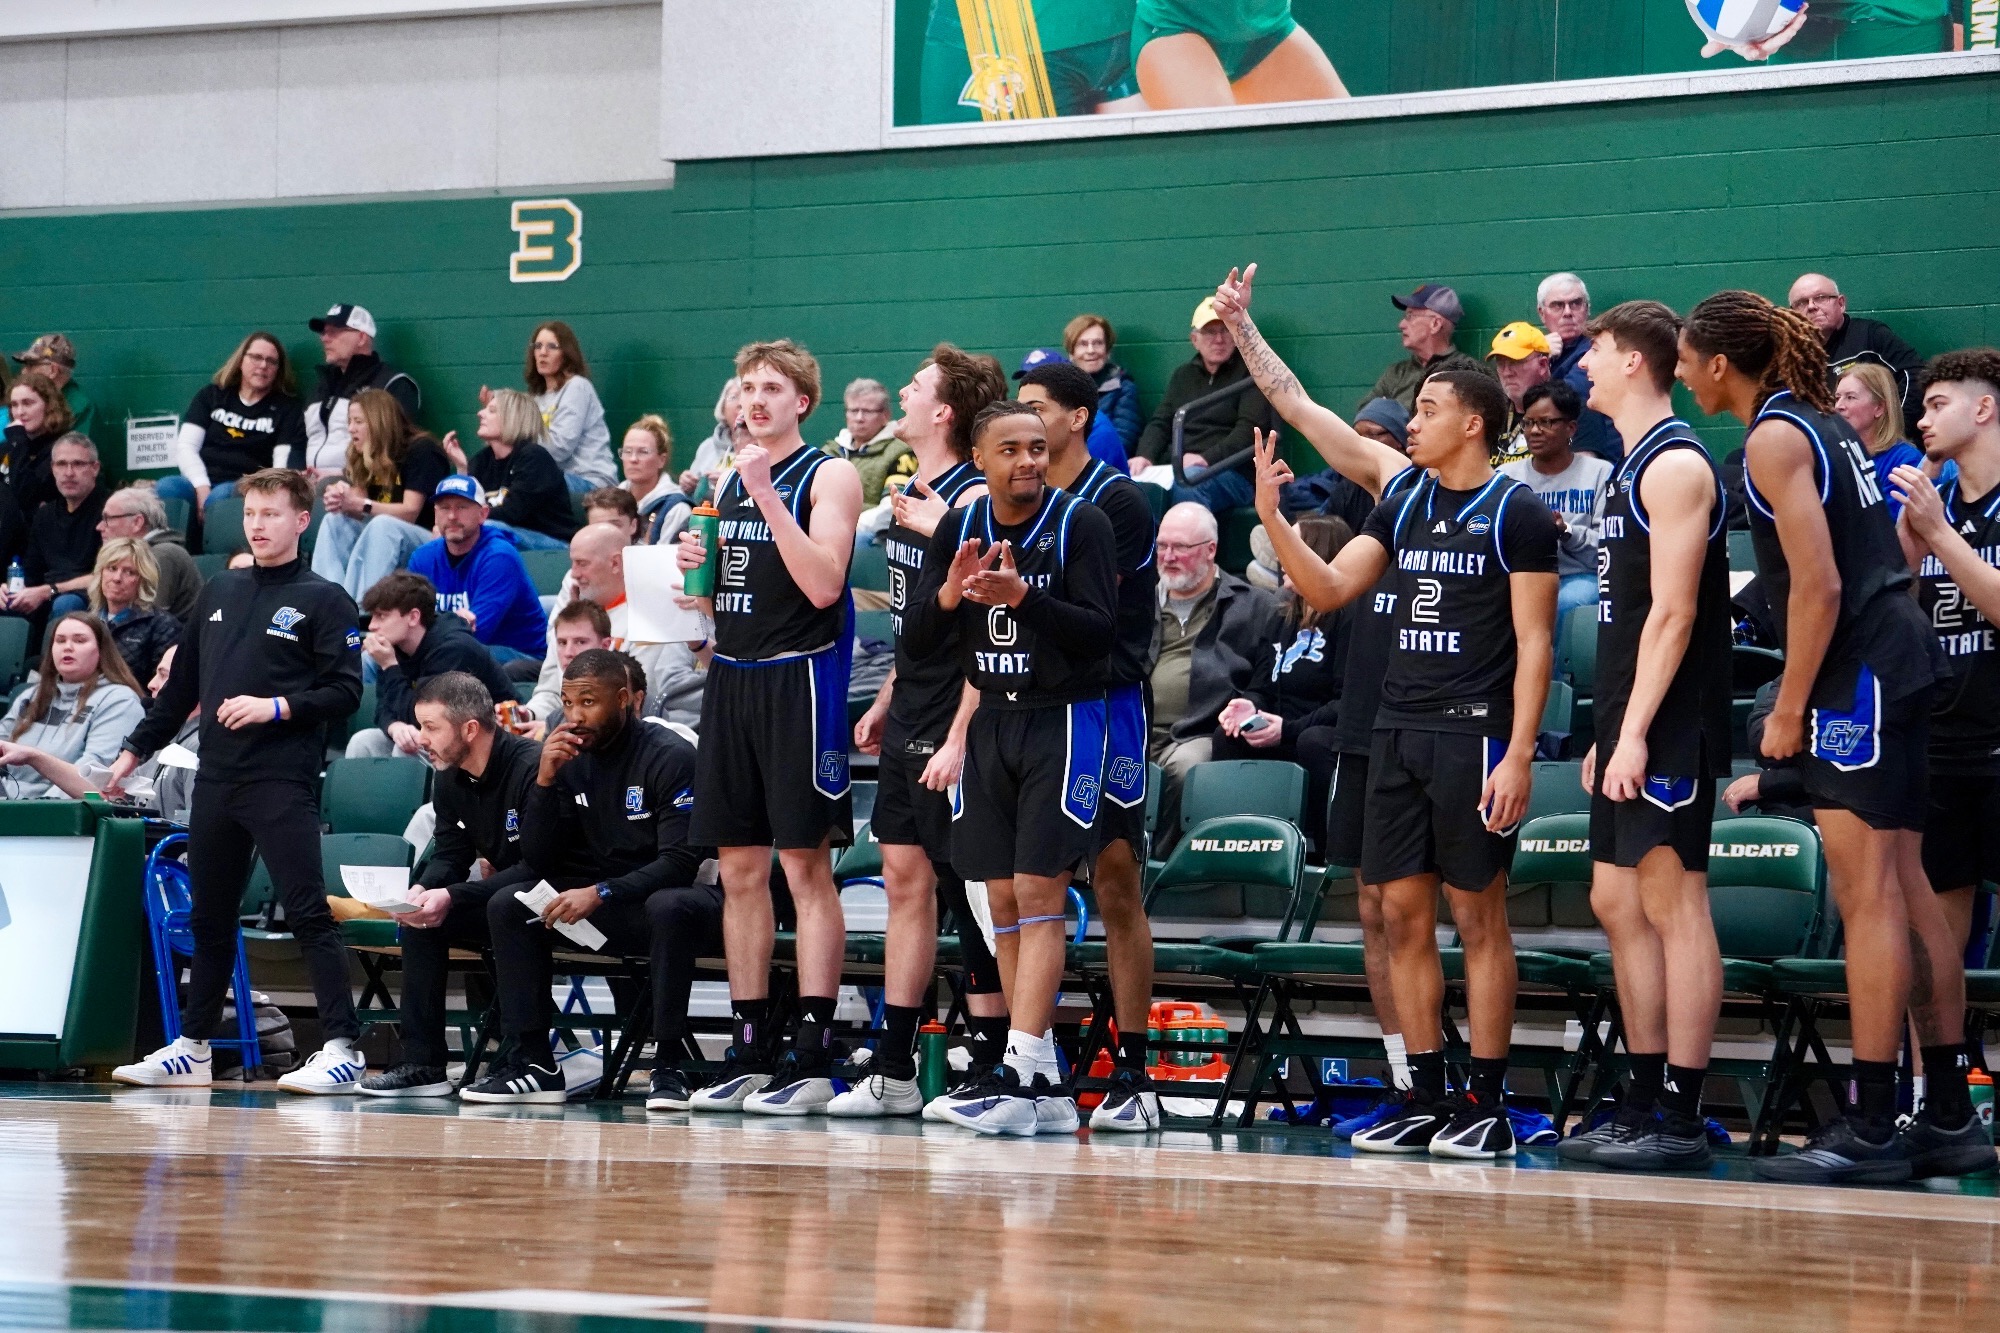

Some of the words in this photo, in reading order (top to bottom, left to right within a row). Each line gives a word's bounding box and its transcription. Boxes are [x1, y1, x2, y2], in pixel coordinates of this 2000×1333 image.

[510, 199, 582, 283] 3
[131, 433, 164, 442] RESERVED
[137, 443, 167, 452] ATHLETIC
[135, 454, 168, 464] DIRECTOR
[738, 520, 775, 541] VALLE
[721, 545, 750, 587] 12
[896, 541, 924, 569] VALLEY
[1431, 551, 1486, 576] VALLEY
[715, 592, 753, 614] STATE
[1373, 593, 1398, 614] ST
[1411, 578, 1443, 624] 2
[272, 606, 306, 630] GV
[1400, 629, 1461, 653] STATE
[1821, 720, 1868, 756] GV
[819, 751, 846, 782] GV
[1109, 757, 1142, 789] GV
[1191, 839, 1284, 852] WILDCATS
[1708, 843, 1800, 858] ILDCATS
